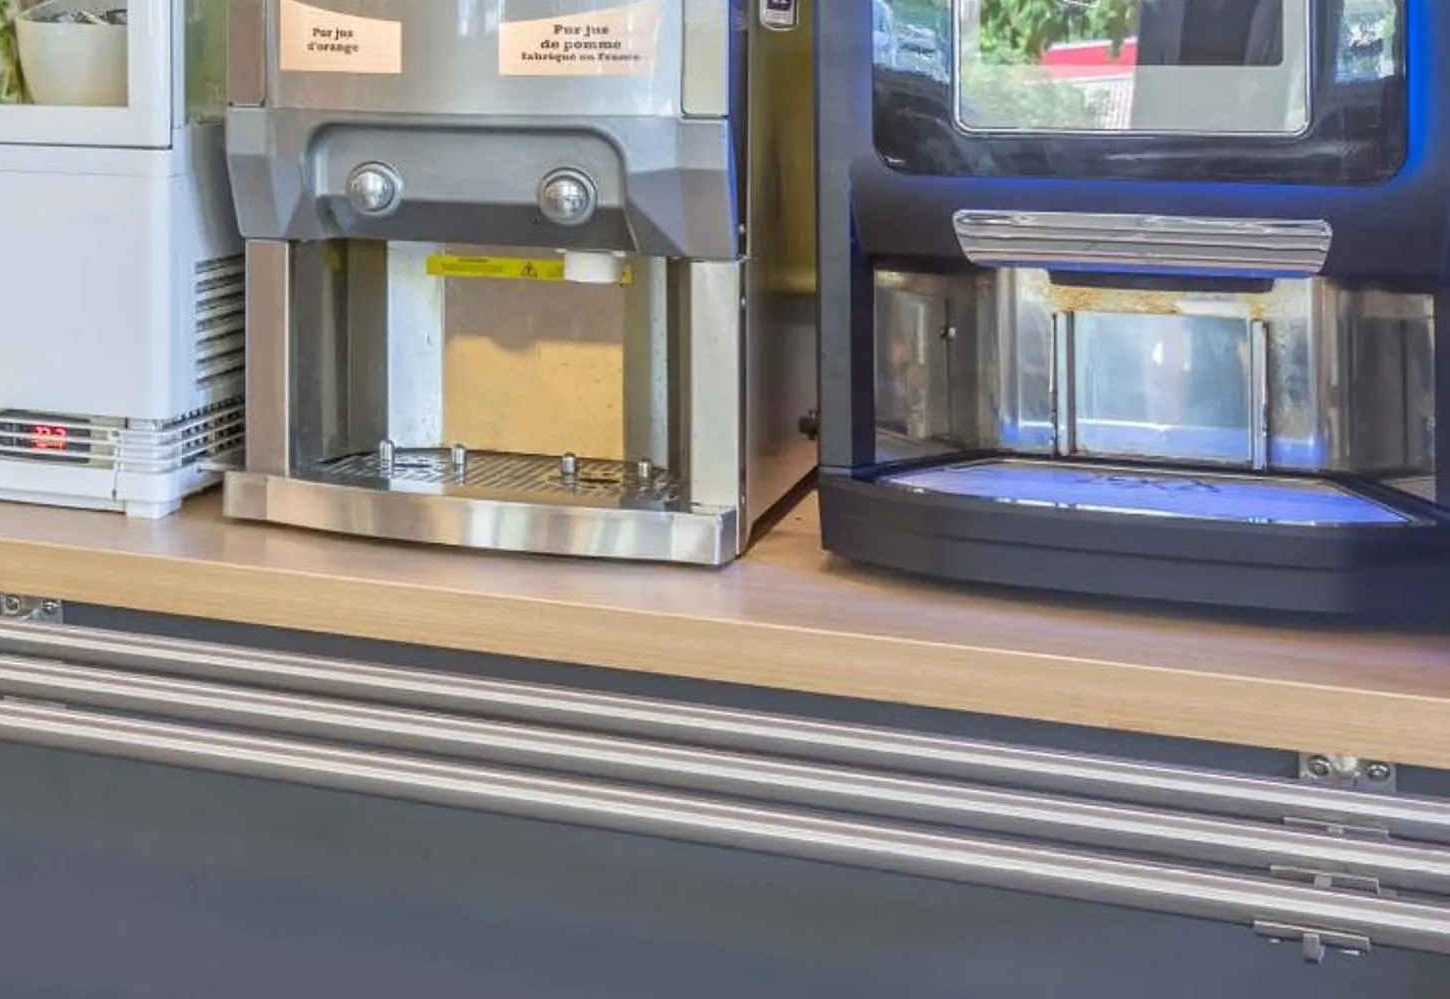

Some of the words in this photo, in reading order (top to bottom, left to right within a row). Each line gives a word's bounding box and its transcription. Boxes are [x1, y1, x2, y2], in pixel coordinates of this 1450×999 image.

[312, 27, 333, 37] Pur
[334, 27, 353, 41] jus
[553, 24, 582, 35] Pur
[583, 24, 610, 37] jus
[306, 41, 359, 55] d'orange
[540, 40, 560, 49] de
[564, 41, 622, 52] pomme
